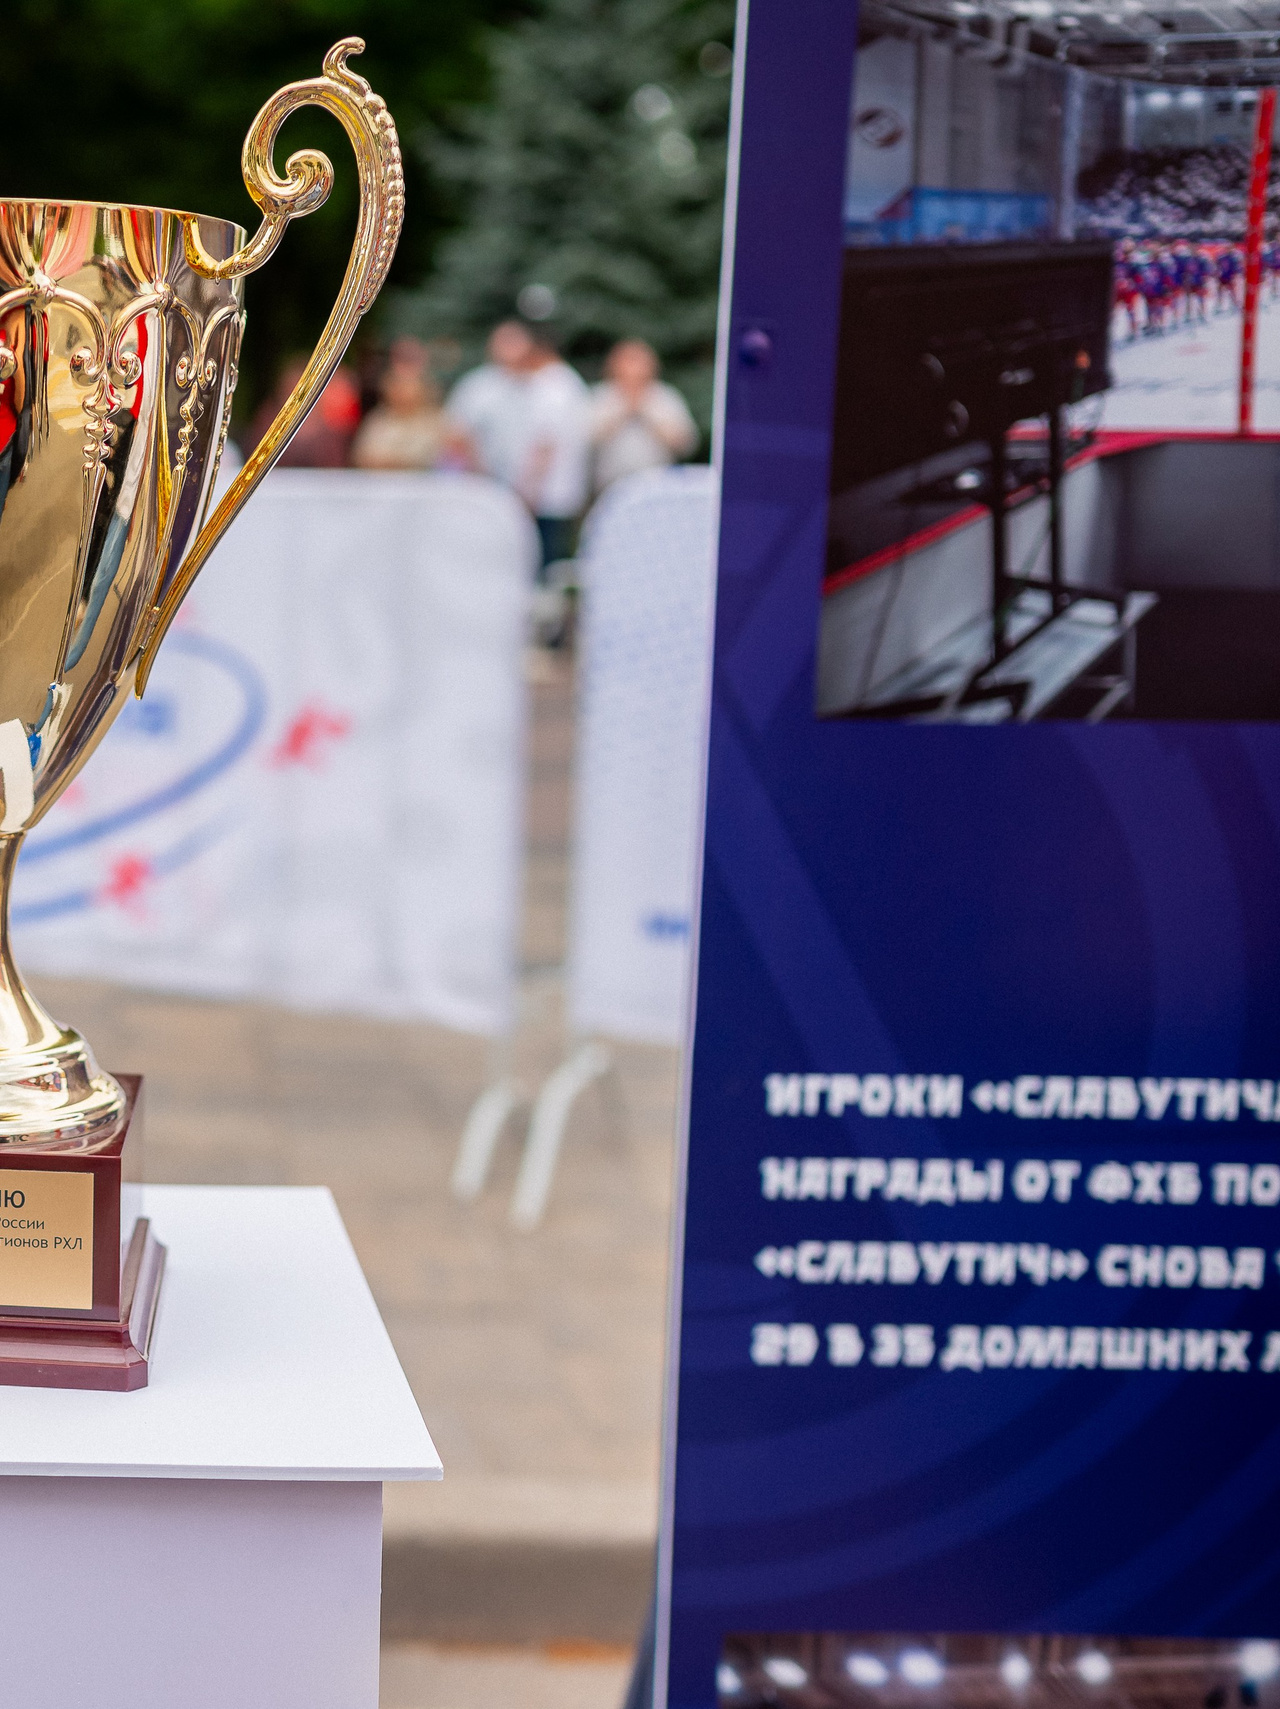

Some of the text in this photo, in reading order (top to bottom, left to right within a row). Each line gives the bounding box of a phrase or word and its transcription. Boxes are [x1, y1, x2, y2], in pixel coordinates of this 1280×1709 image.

[764, 1074, 1280, 1121] ИГРОКИ «СЛАВУТИЧ
[760, 1157, 1004, 1205] НАГРАДЫ
[1013, 1160, 1081, 1202] ОТ
[1088, 1161, 1201, 1204] ФХБ
[53, 1236, 83, 1250] РХЛ
[1097, 1245, 1264, 1288] СНОВА
[871, 1324, 935, 1366] 35
[940, 1325, 1249, 1371] ДОМАШНИХ
